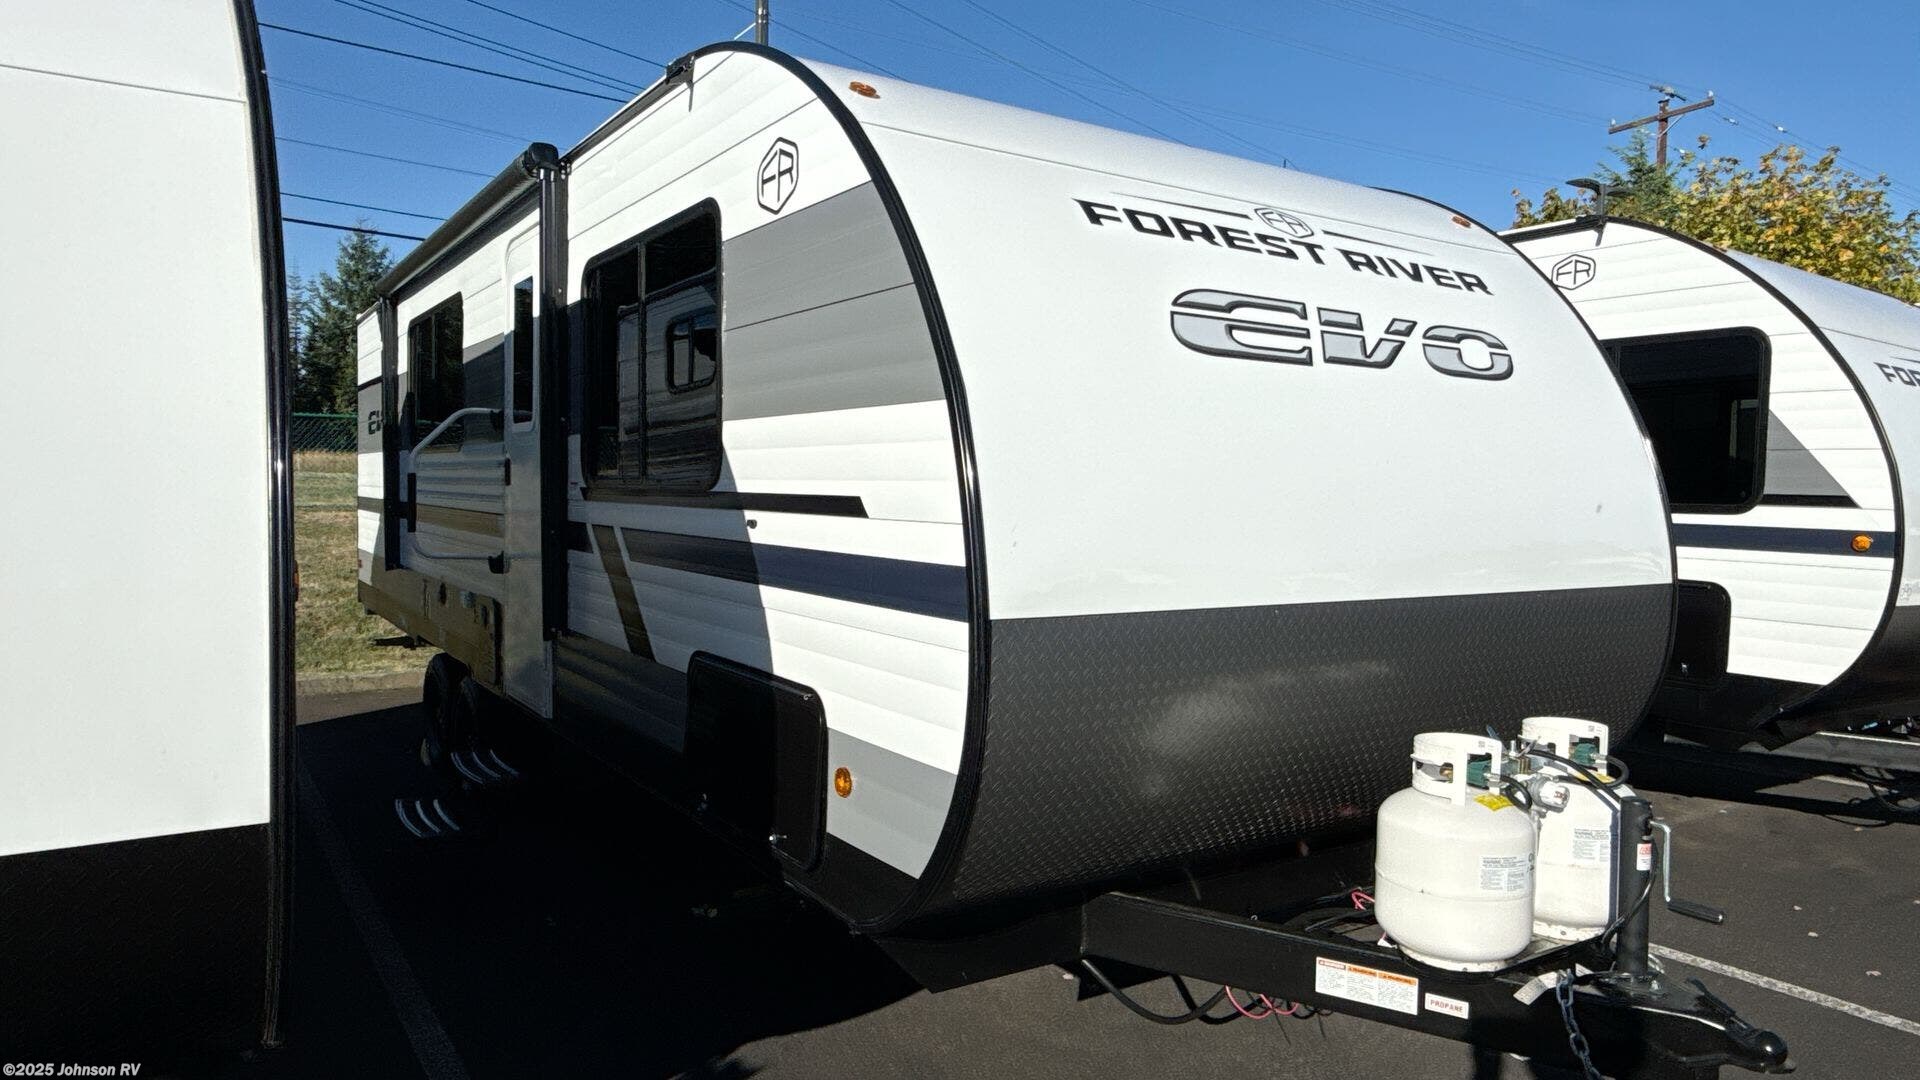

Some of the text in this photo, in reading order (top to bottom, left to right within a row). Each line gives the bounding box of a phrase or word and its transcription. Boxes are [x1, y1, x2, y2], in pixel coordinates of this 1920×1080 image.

[1072, 198, 1494, 296] FOREST RIVER
[1170, 288, 1514, 381] EVO
[1430, 999, 1463, 1013] PROPANE
